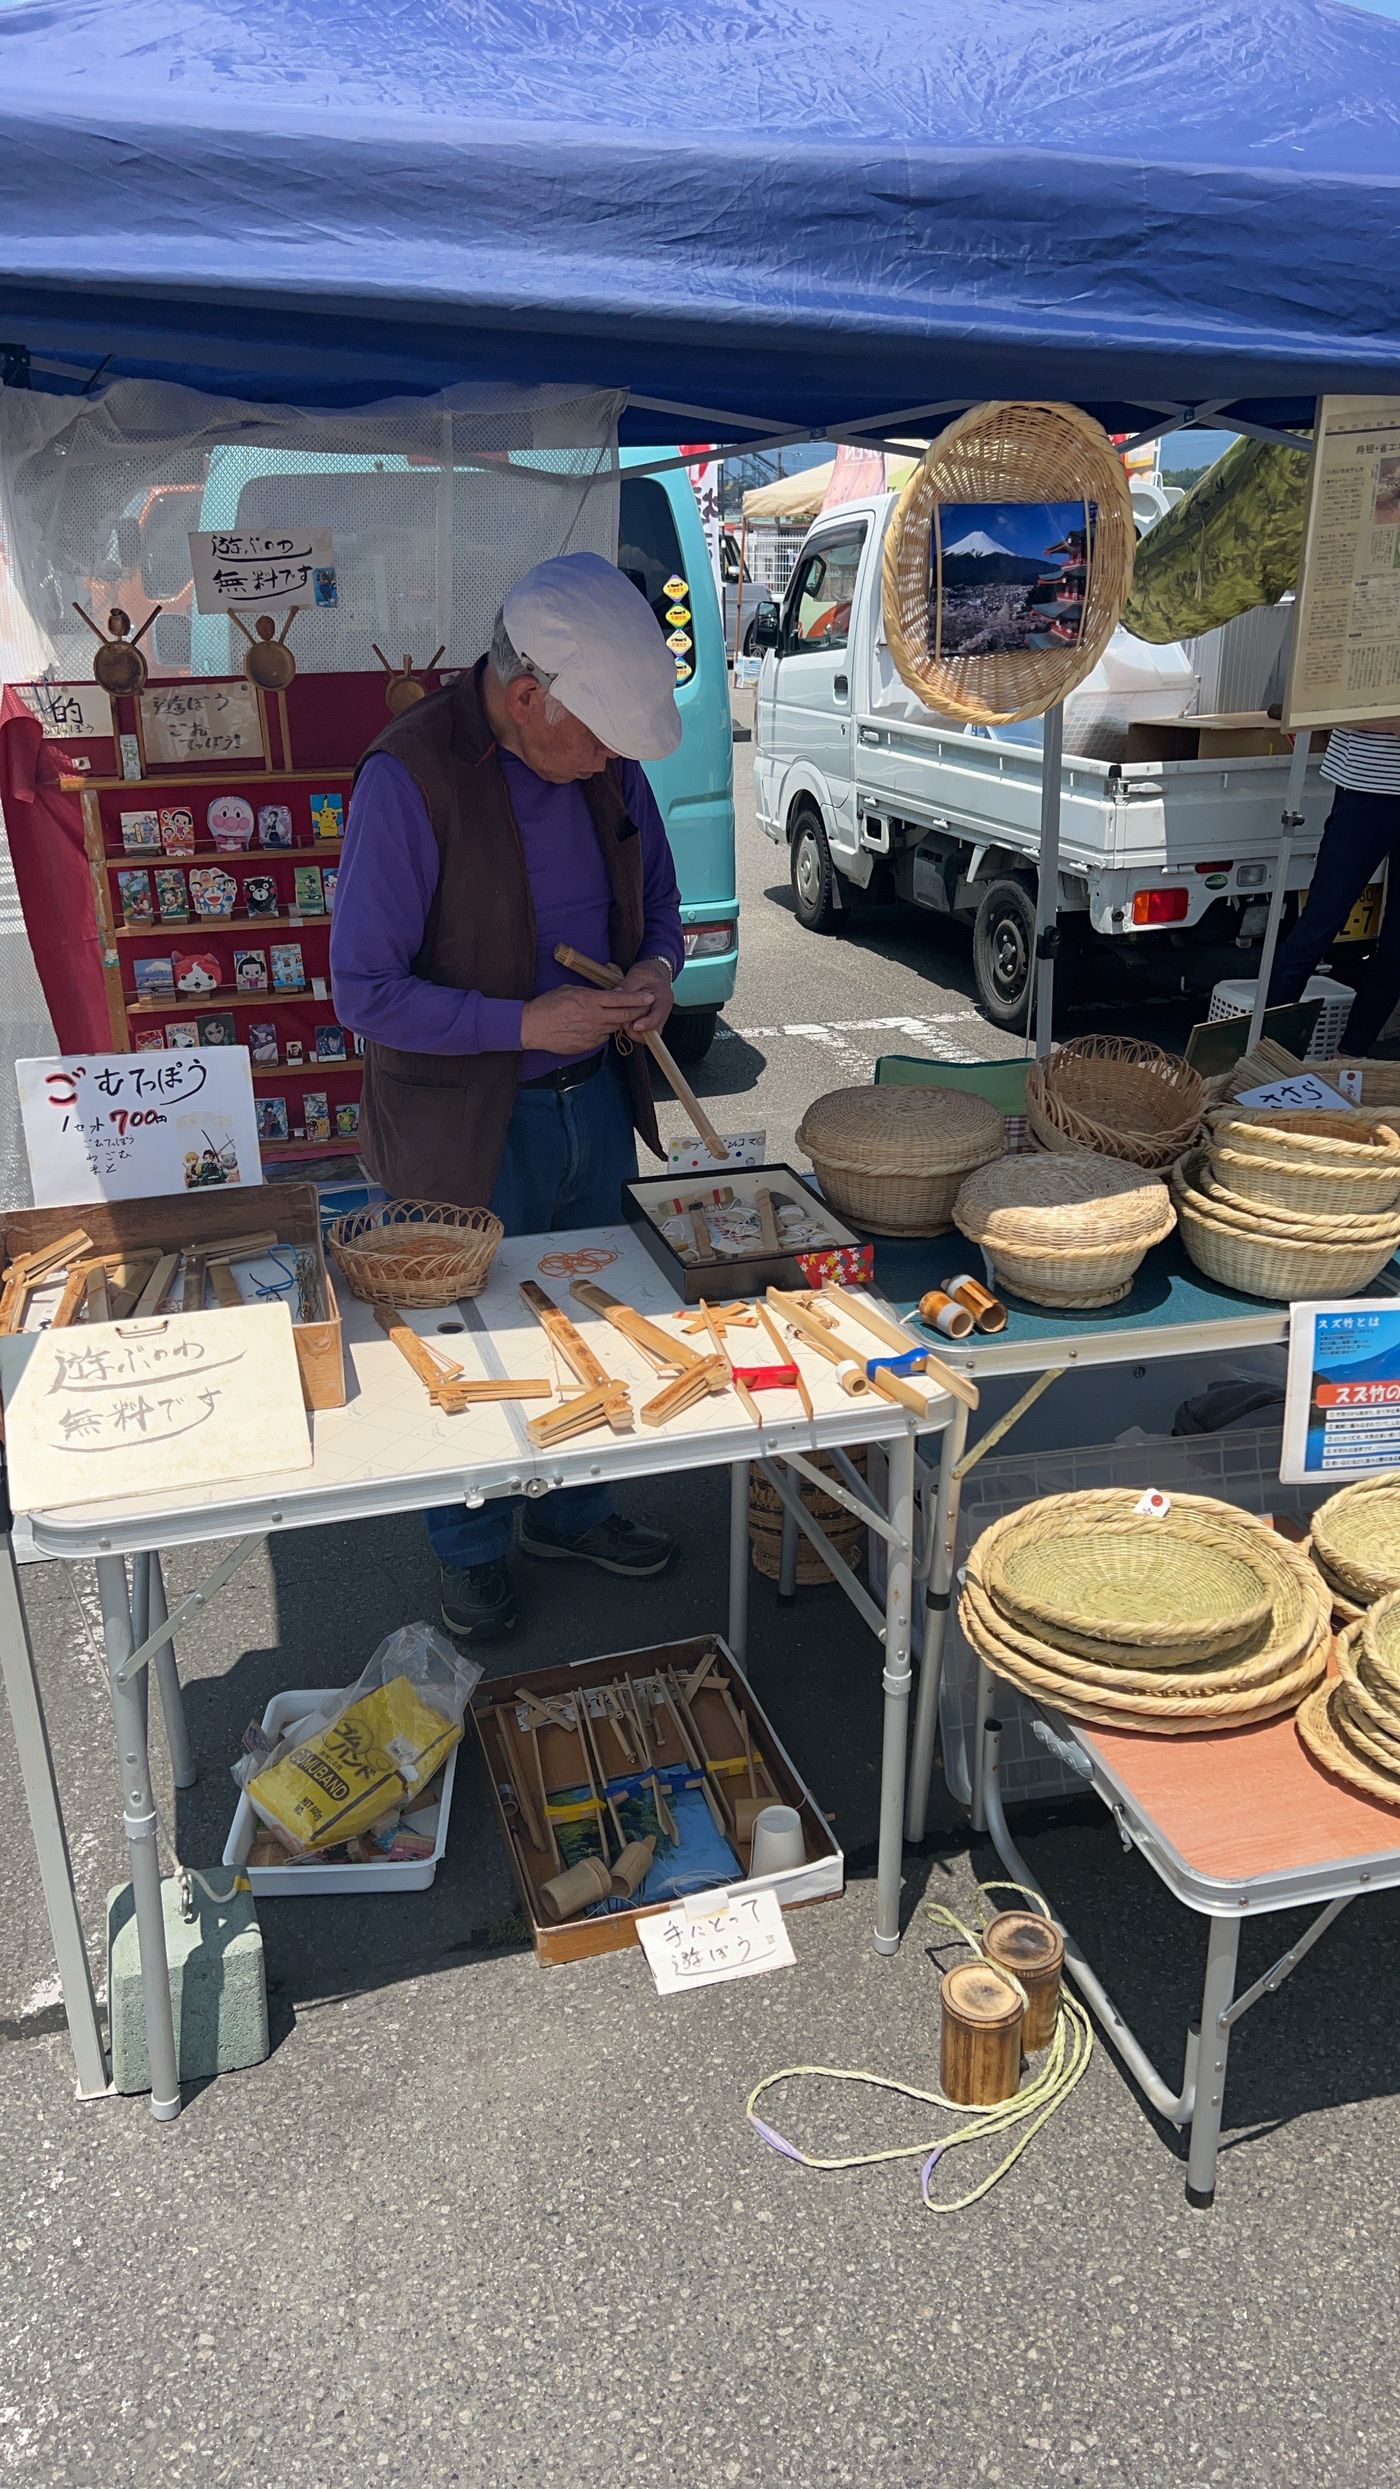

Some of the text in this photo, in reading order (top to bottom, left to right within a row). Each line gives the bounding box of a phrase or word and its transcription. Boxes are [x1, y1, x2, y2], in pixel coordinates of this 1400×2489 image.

[212, 564, 313, 601] 無料です
[50, 694, 84, 724] 的
[45, 1058, 208, 1107] ごむてっぽう
[1317, 1316, 1381, 1329] スズ竹とは
[50, 1386, 224, 1453] 無料です
[290, 1748, 348, 1799] GOMUBAND
[663, 1898, 761, 1948] 手にとって
[671, 1935, 777, 1976] 遊ぼう
